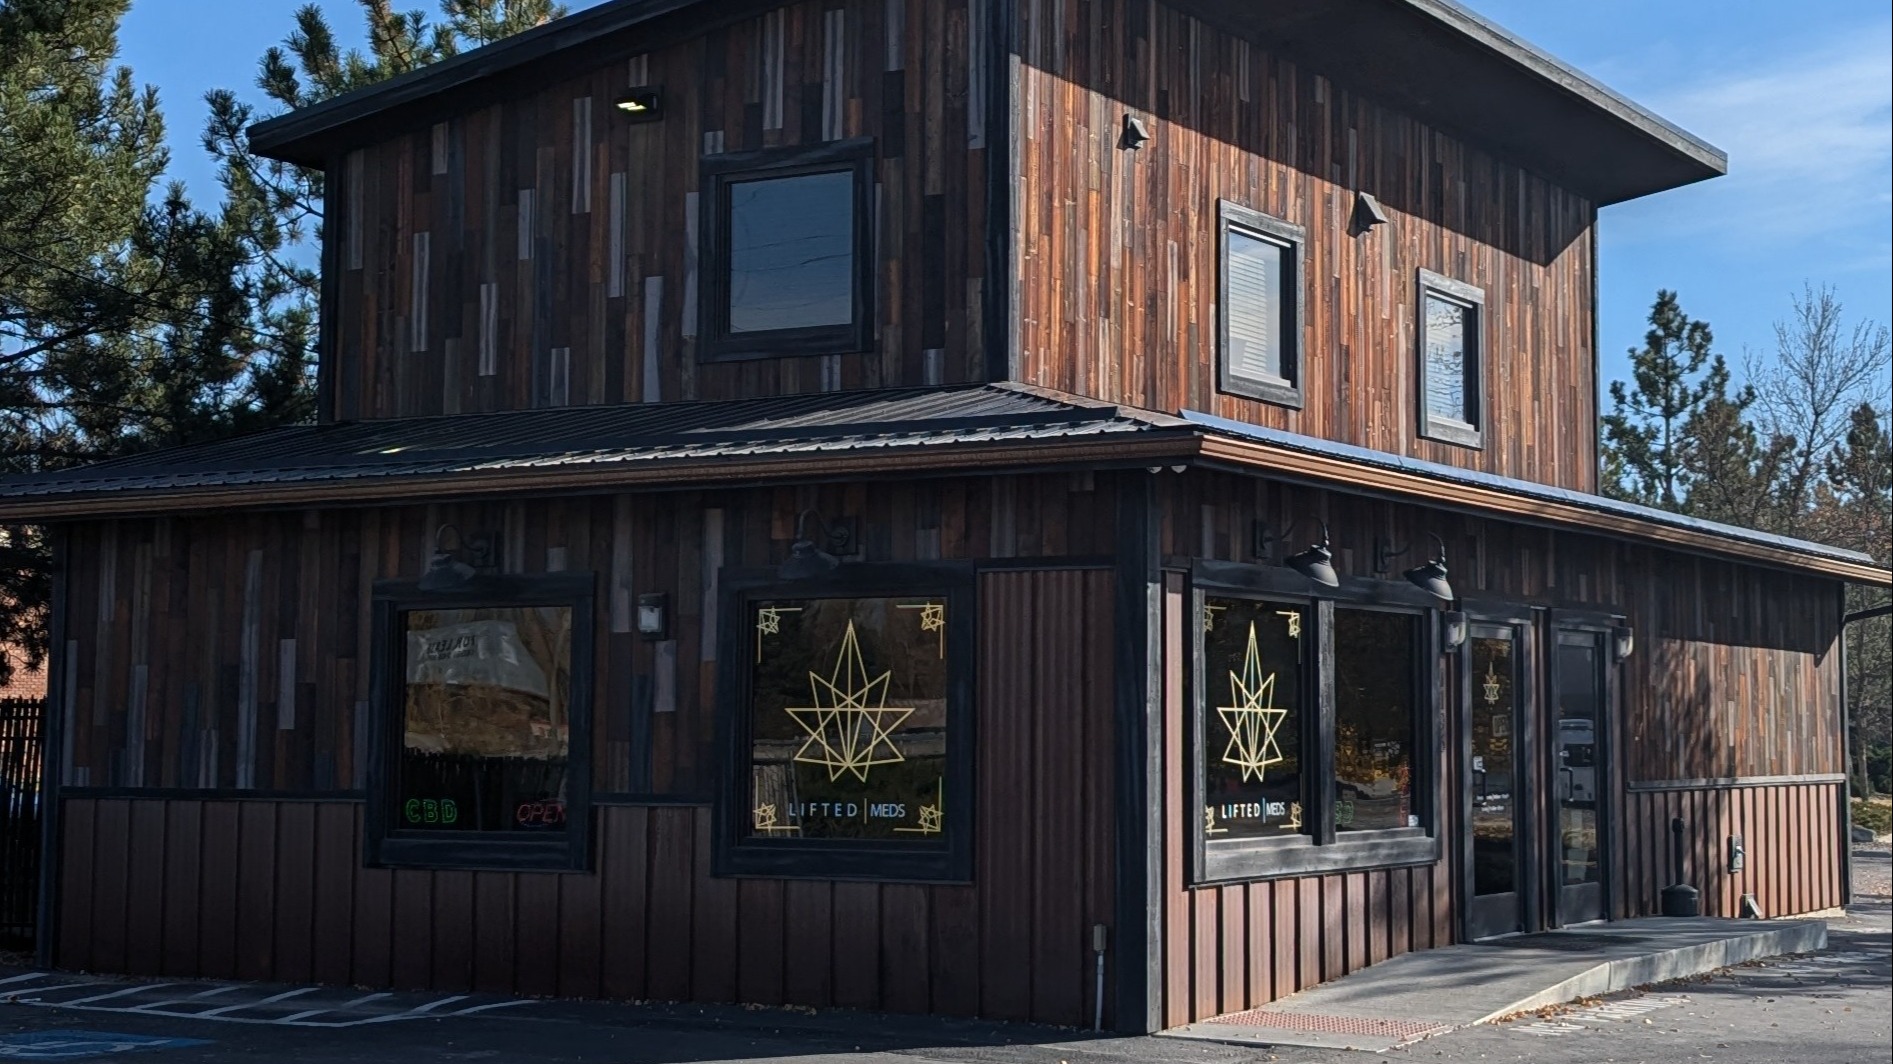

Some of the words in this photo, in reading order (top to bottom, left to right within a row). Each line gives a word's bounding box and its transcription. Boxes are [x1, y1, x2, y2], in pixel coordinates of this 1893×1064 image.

[405, 798, 458, 824] CBD
[516, 802, 567, 823] OPEN
[789, 803, 858, 817] LIFTED
[870, 804, 906, 818] MEDS
[1222, 803, 1261, 819] LIFTED
[1266, 802, 1286, 816] MEDS
